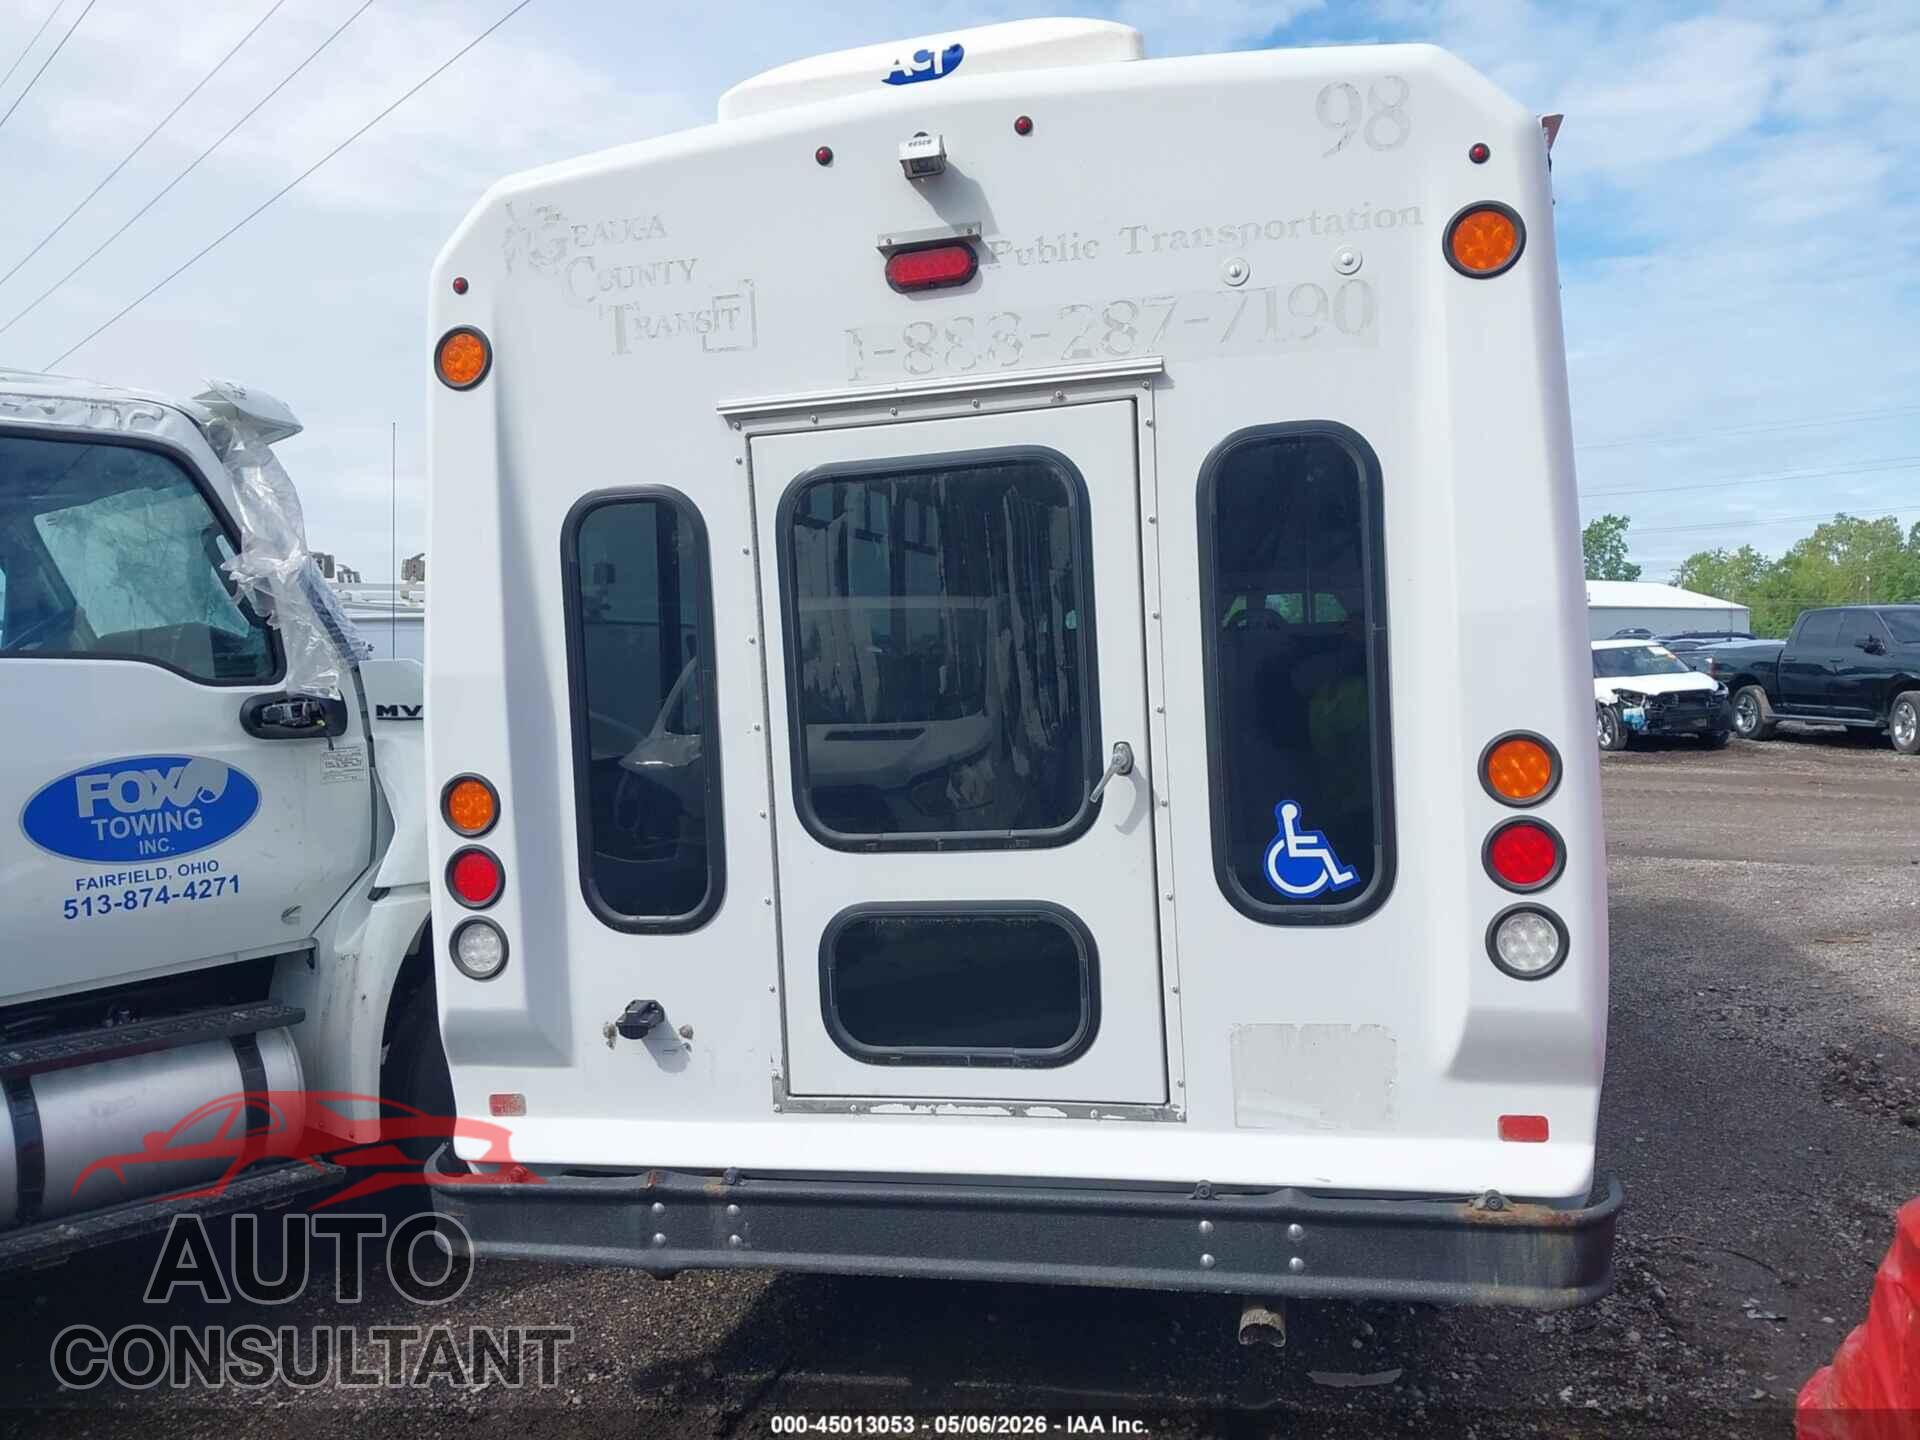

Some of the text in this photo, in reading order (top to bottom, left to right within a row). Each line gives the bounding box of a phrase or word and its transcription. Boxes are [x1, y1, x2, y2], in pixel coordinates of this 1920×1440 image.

[887, 48, 945, 79] ACT
[1316, 75, 1411, 158] 98
[988, 199, 1424, 270] Public Transportation
[76, 766, 190, 817] FOX
[91, 808, 203, 842] TOWING
[139, 836, 175, 855] INC.
[75, 859, 219, 893] FAIRFIELD, OHIO
[63, 874, 241, 920] 513-874-4271
